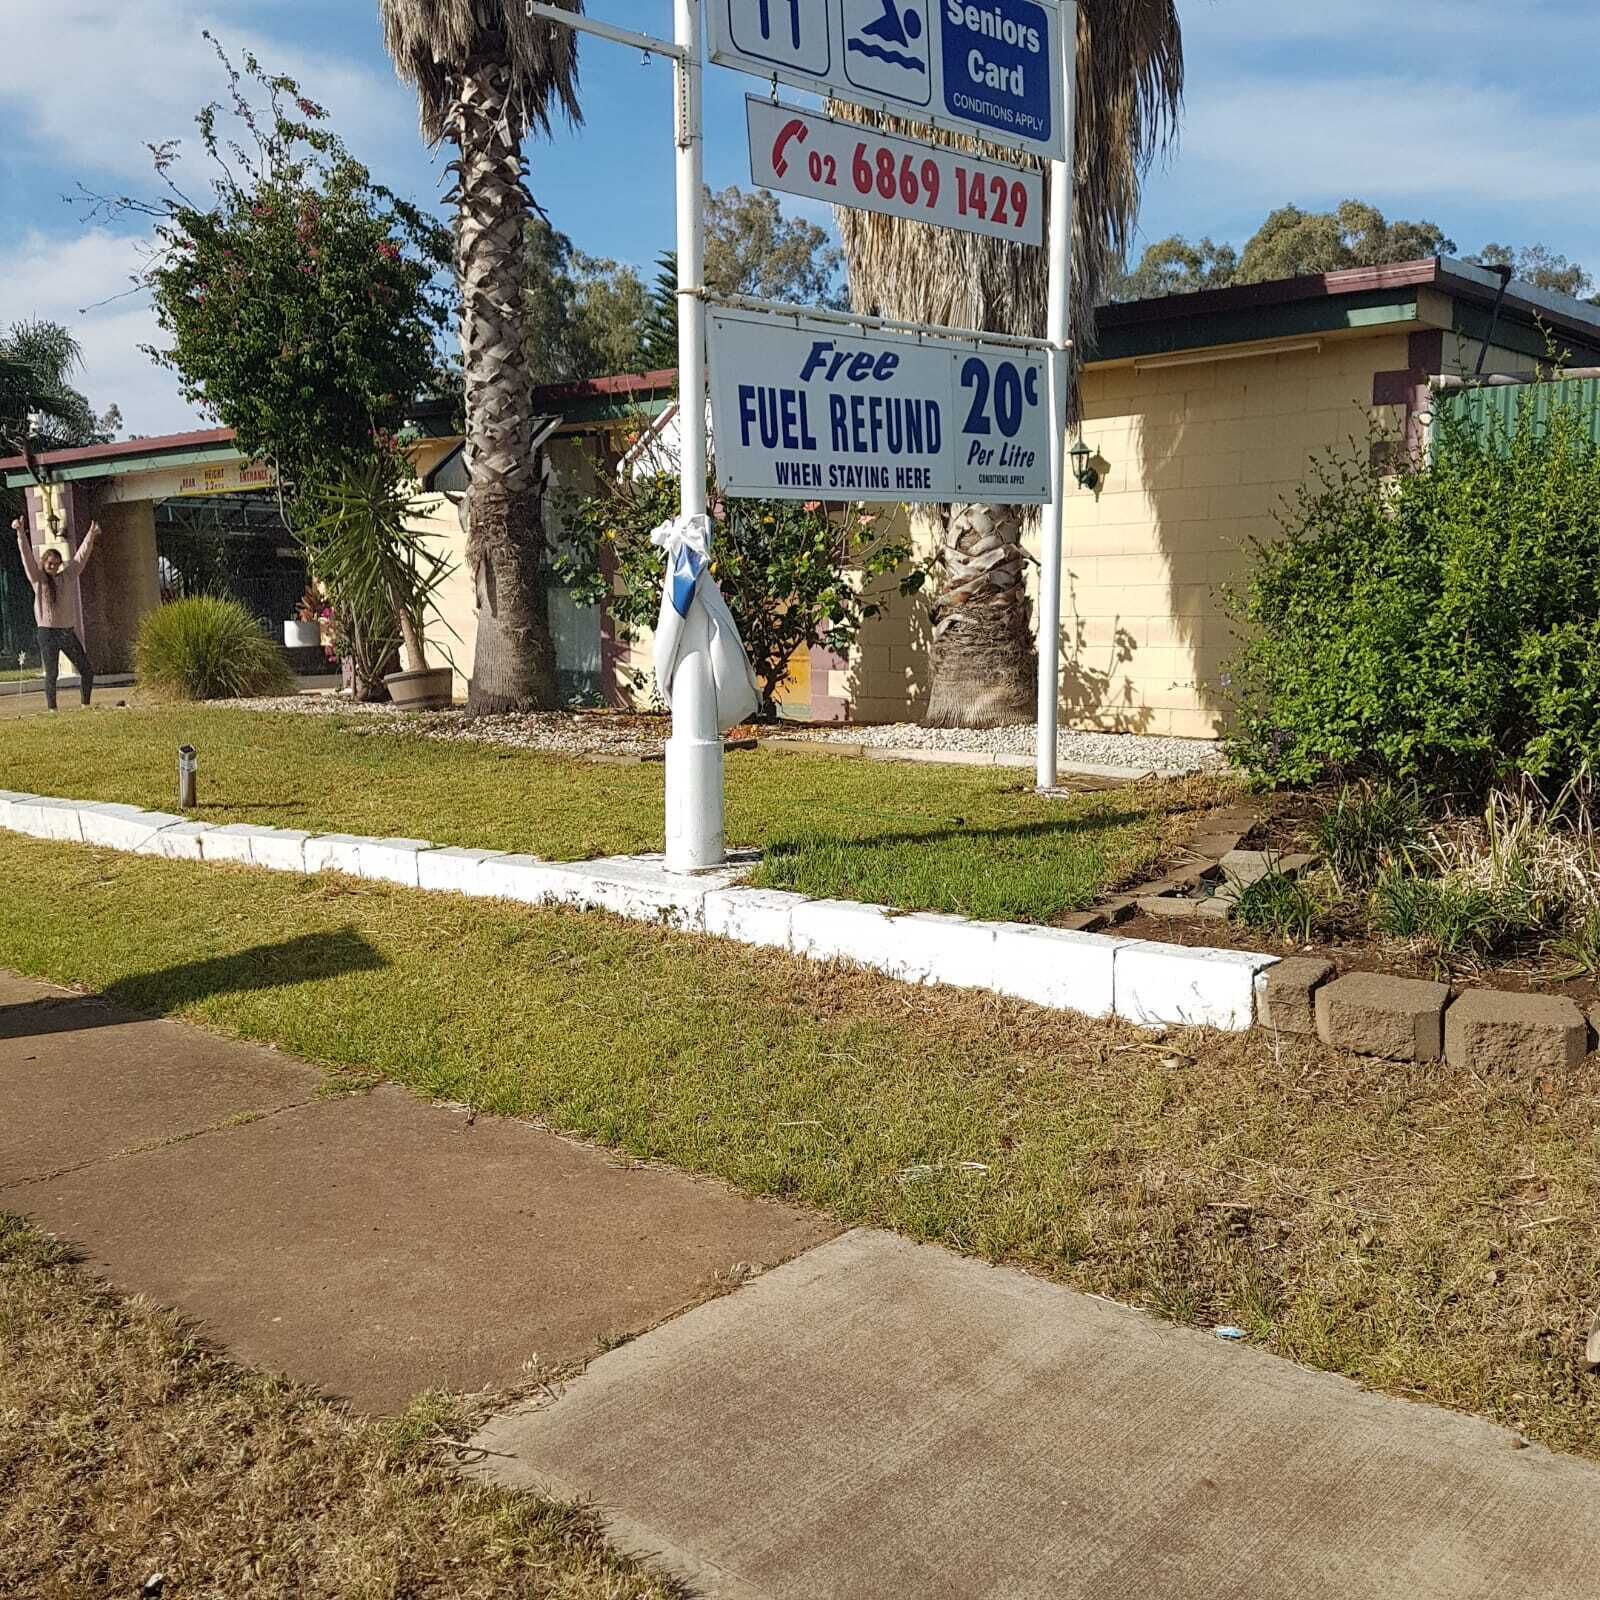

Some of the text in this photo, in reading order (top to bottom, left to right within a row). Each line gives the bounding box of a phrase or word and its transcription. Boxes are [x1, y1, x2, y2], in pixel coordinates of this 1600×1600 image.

[947, 0, 1040, 53] Seniors
[967, 52, 1025, 97] Card
[953, 92, 1043, 132] CONDITIONS APPLY
[808, 142, 1028, 228] 02 6869 1429
[800, 341, 899, 383] Free
[738, 384, 942, 455] FUEL REFUND
[967, 439, 1035, 468] Per Litre
[776, 461, 931, 489] WHEN STAYING HERE
[978, 474, 1025, 485] CONDITIONS APPLY
